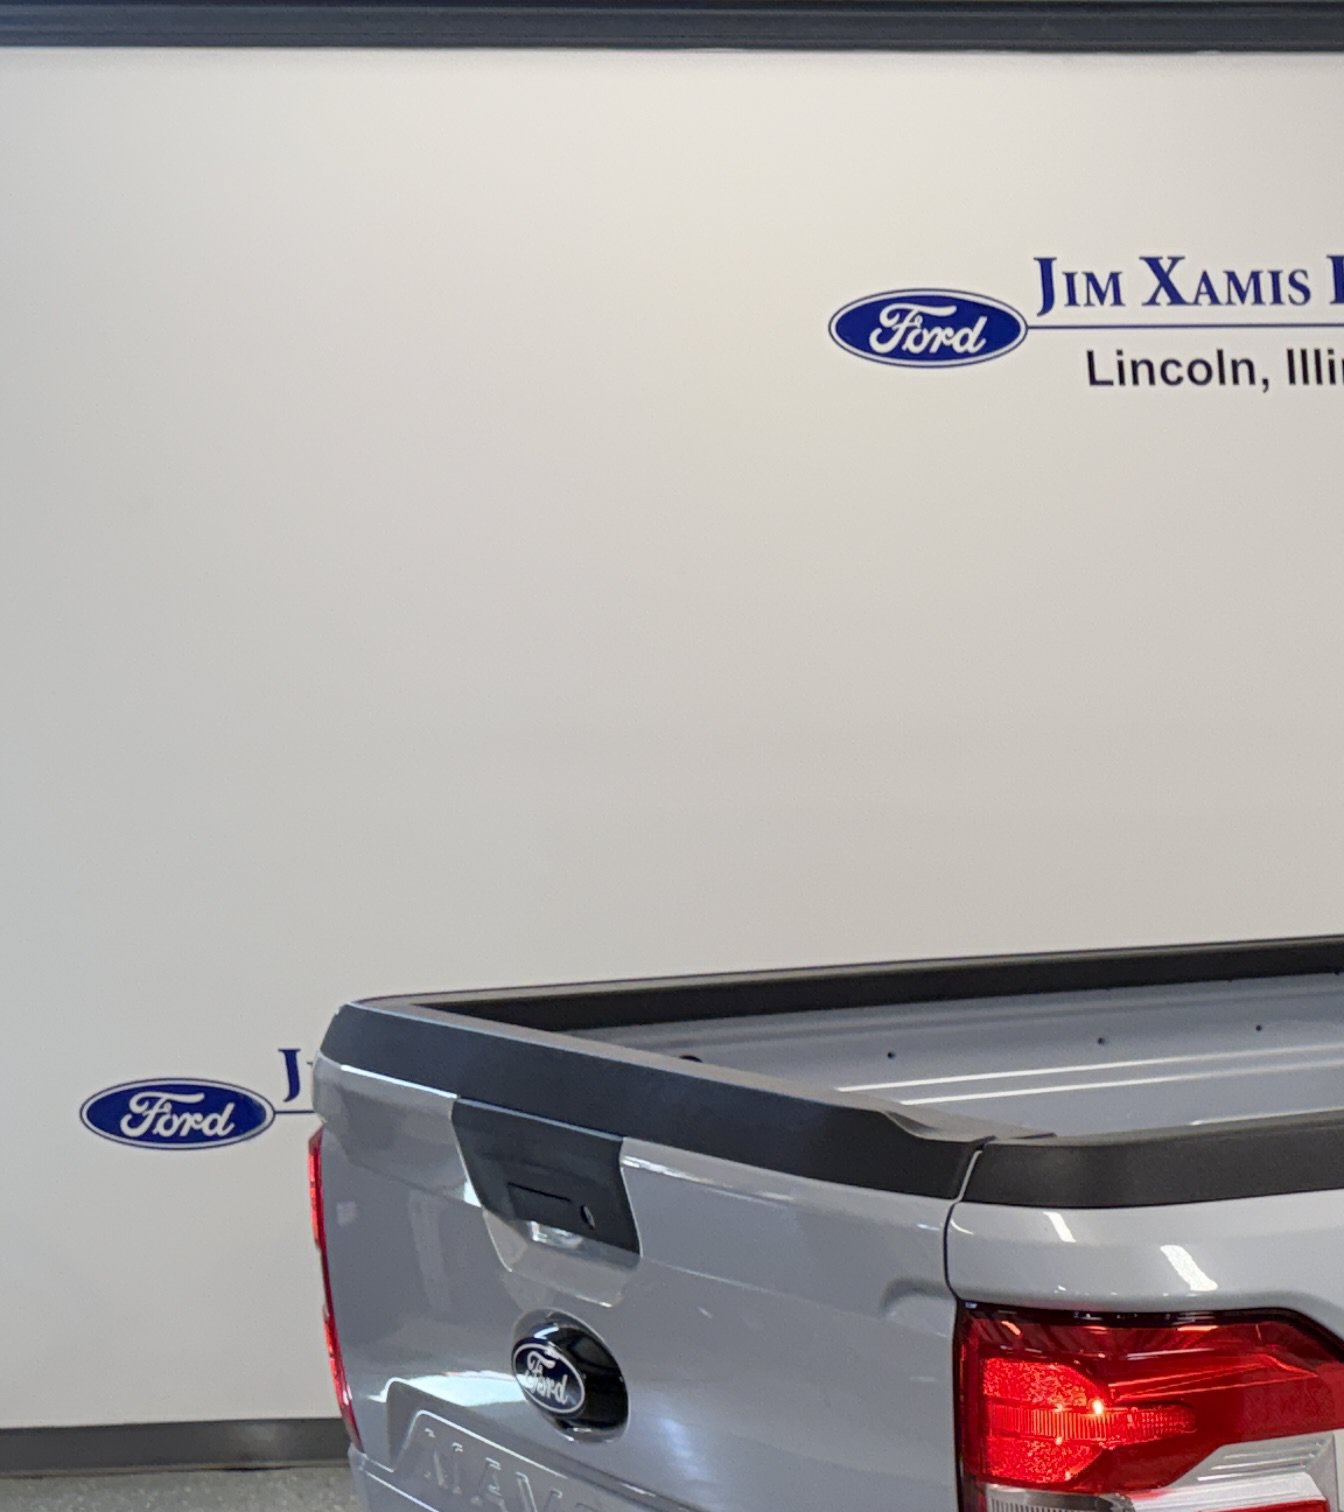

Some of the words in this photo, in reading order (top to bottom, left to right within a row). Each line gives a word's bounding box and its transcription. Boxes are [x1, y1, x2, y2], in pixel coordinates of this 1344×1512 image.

[1033, 256, 1125, 317] JIM
[1138, 255, 1311, 307] XAMIS
[869, 303, 988, 355] Ford
[1086, 348, 1270, 394] Lincoln,
[120, 1091, 235, 1137] Ford
[524, 1350, 569, 1405] Ford
